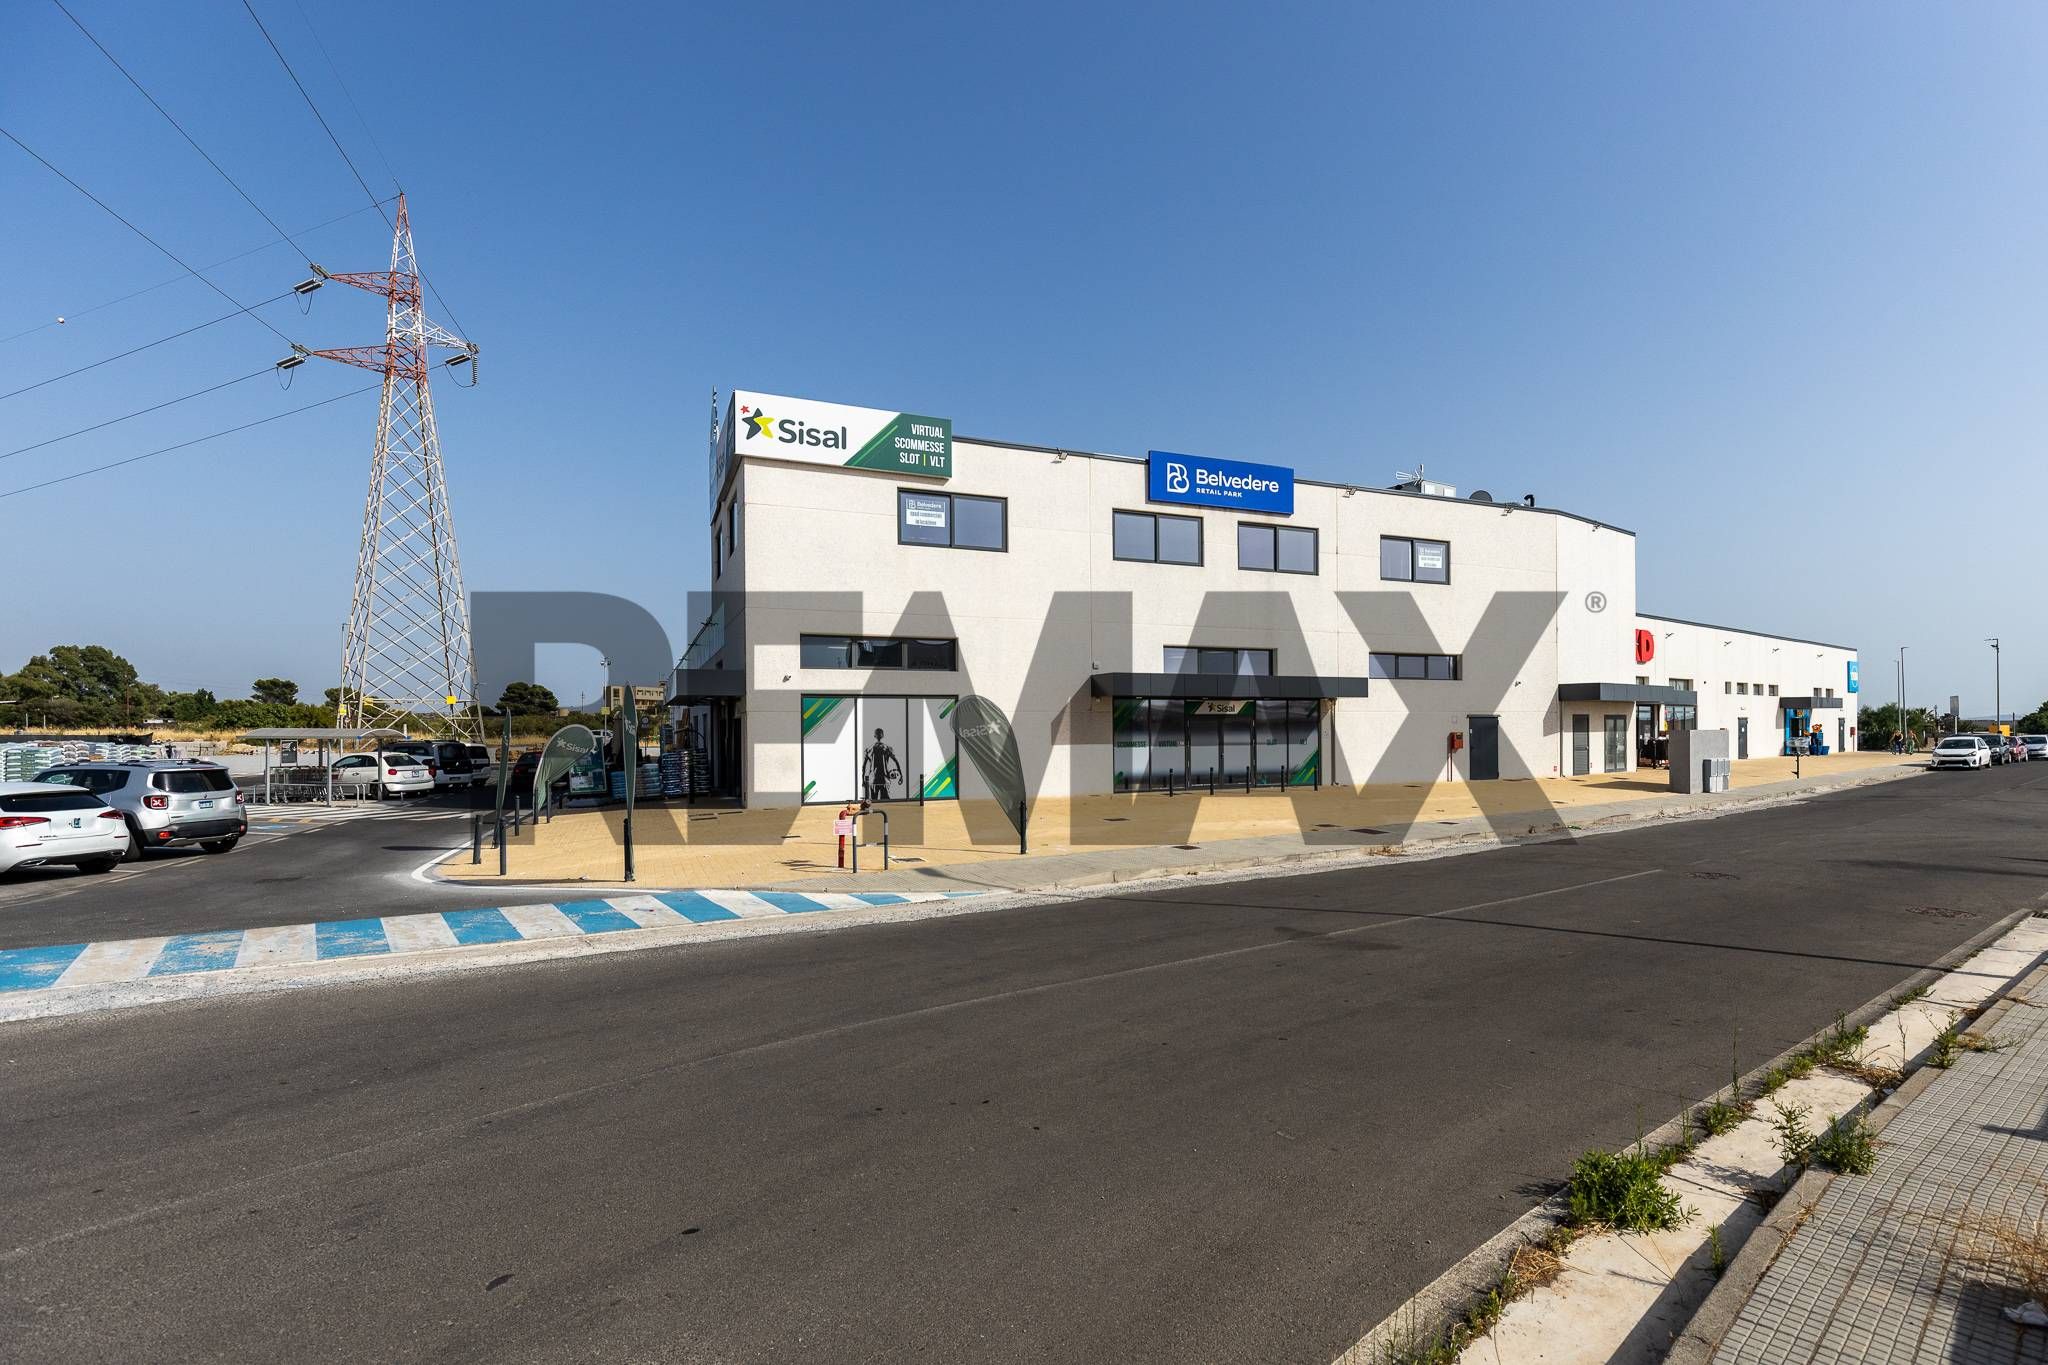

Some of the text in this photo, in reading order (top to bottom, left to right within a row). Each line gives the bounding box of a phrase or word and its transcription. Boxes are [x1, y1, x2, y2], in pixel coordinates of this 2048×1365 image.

[778, 418, 847, 450] Sisal
[911, 423, 945, 439] VIRTUAL
[894, 436, 945, 454] SCOMMESSE
[899, 451, 920, 465] SLOT
[929, 455, 945, 468] VLT
[1196, 468, 1279, 493] Belvedere
[1196, 487, 1243, 498] RETAIL PARK
[1216, 703, 1235, 713] Sisal
